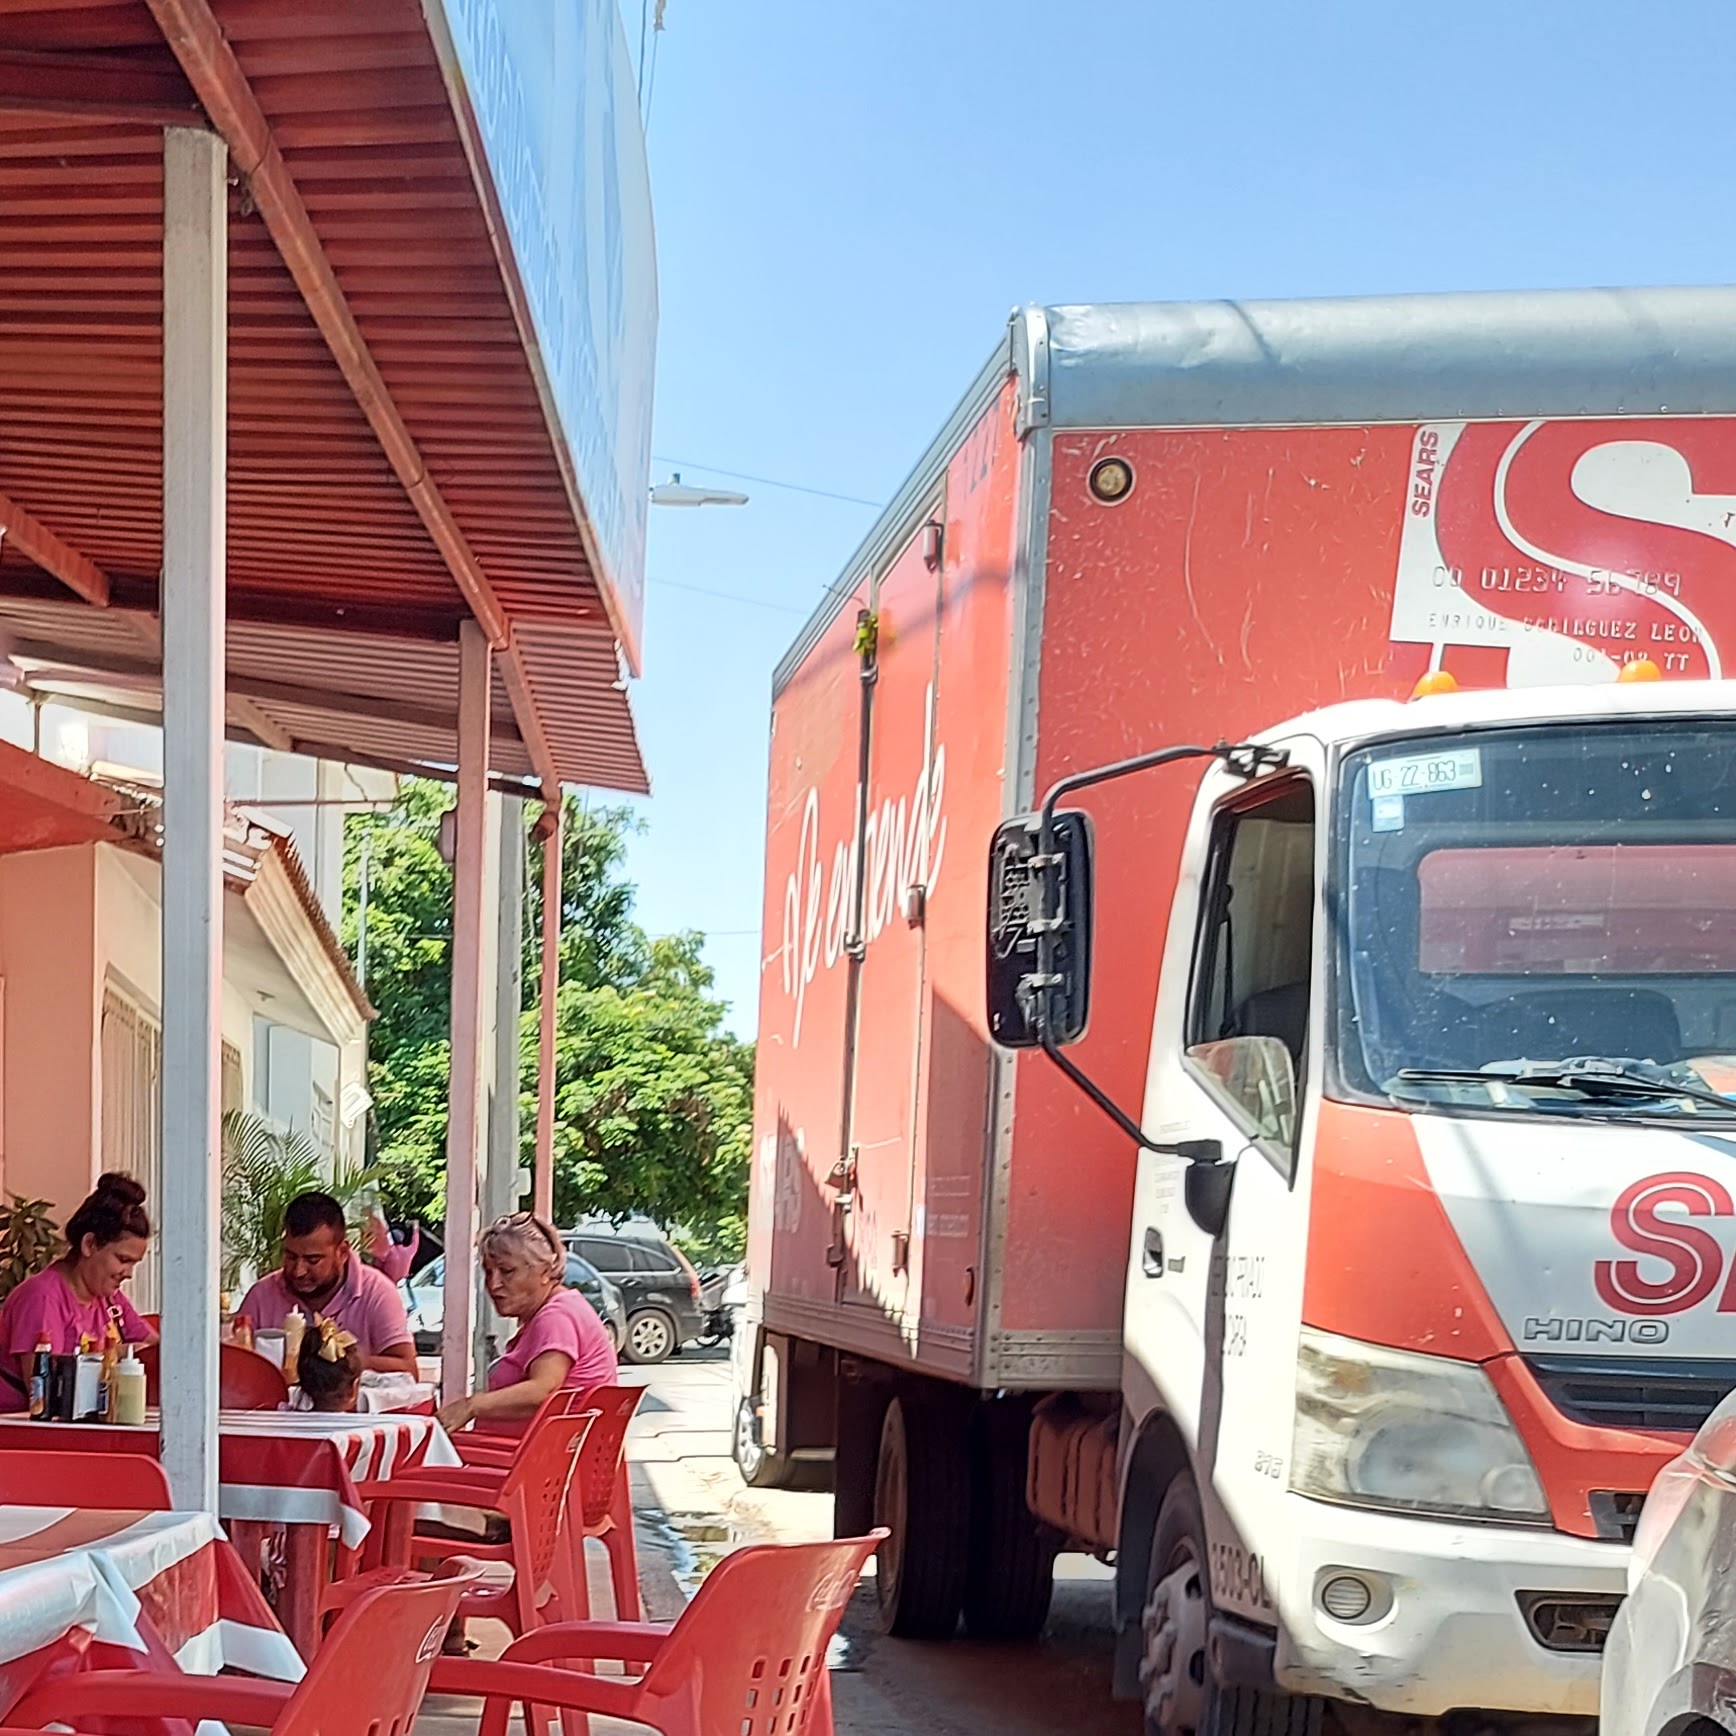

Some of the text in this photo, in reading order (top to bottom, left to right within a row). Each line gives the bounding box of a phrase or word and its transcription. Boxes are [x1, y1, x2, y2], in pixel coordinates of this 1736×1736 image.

[1411, 430, 1439, 518] SEARS
[1480, 566, 1566, 593] 01234
[1593, 1171, 1736, 1317] S
[1524, 1317, 1670, 1345] HINO
